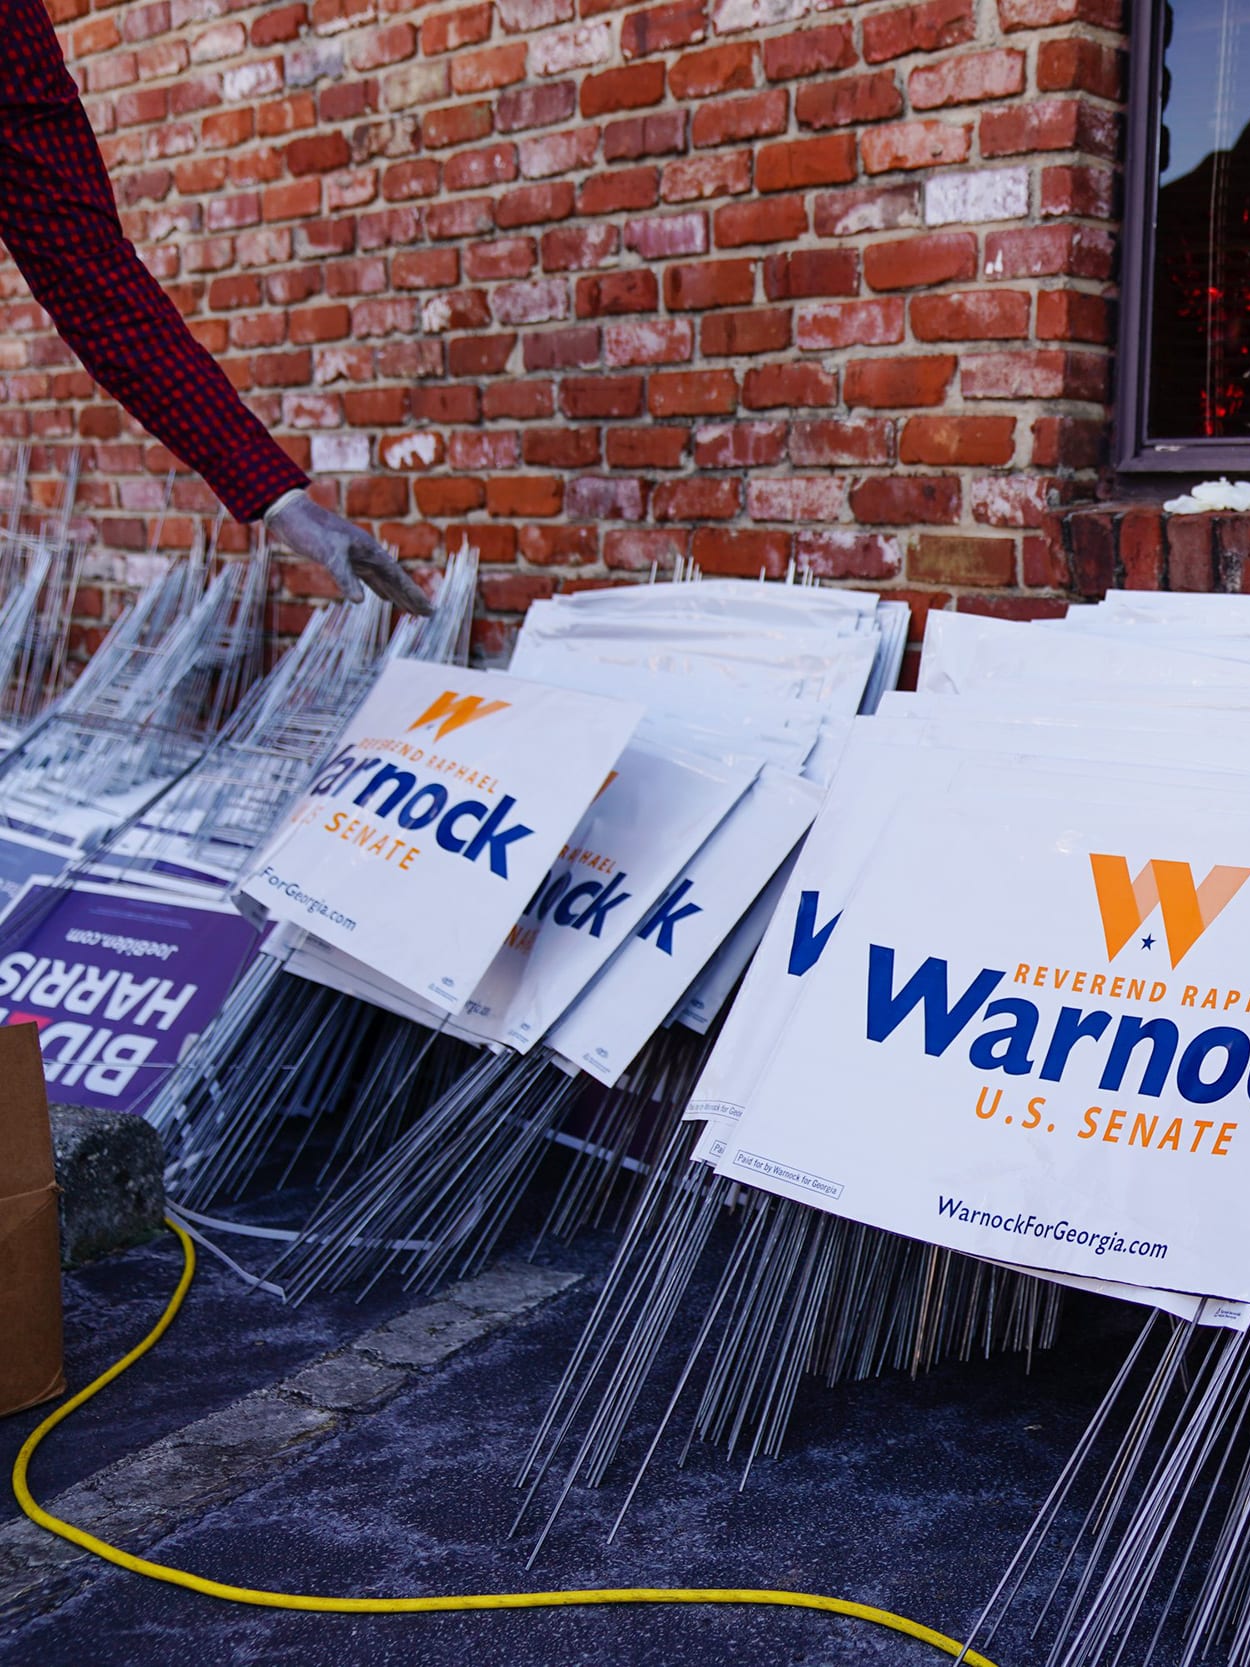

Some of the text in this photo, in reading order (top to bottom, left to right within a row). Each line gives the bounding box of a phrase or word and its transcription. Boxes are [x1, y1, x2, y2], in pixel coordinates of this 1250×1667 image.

[426, 755, 499, 795] RAPHAEL
[311, 744, 535, 880] arnock
[324, 811, 420, 871] SENATE
[260, 866, 357, 932] ForGeorgia.com
[65, 927, 179, 961] JoeBiden.com
[0, 951, 198, 1031] HARRIS
[1014, 962, 1167, 1003] REVEREND
[976, 1087, 1238, 1156] U.S. SENATE
[737, 1153, 837, 1196] Paid for by Warnock for Georgia
[937, 1195, 1168, 1260] WarnockForGeorgia.com
